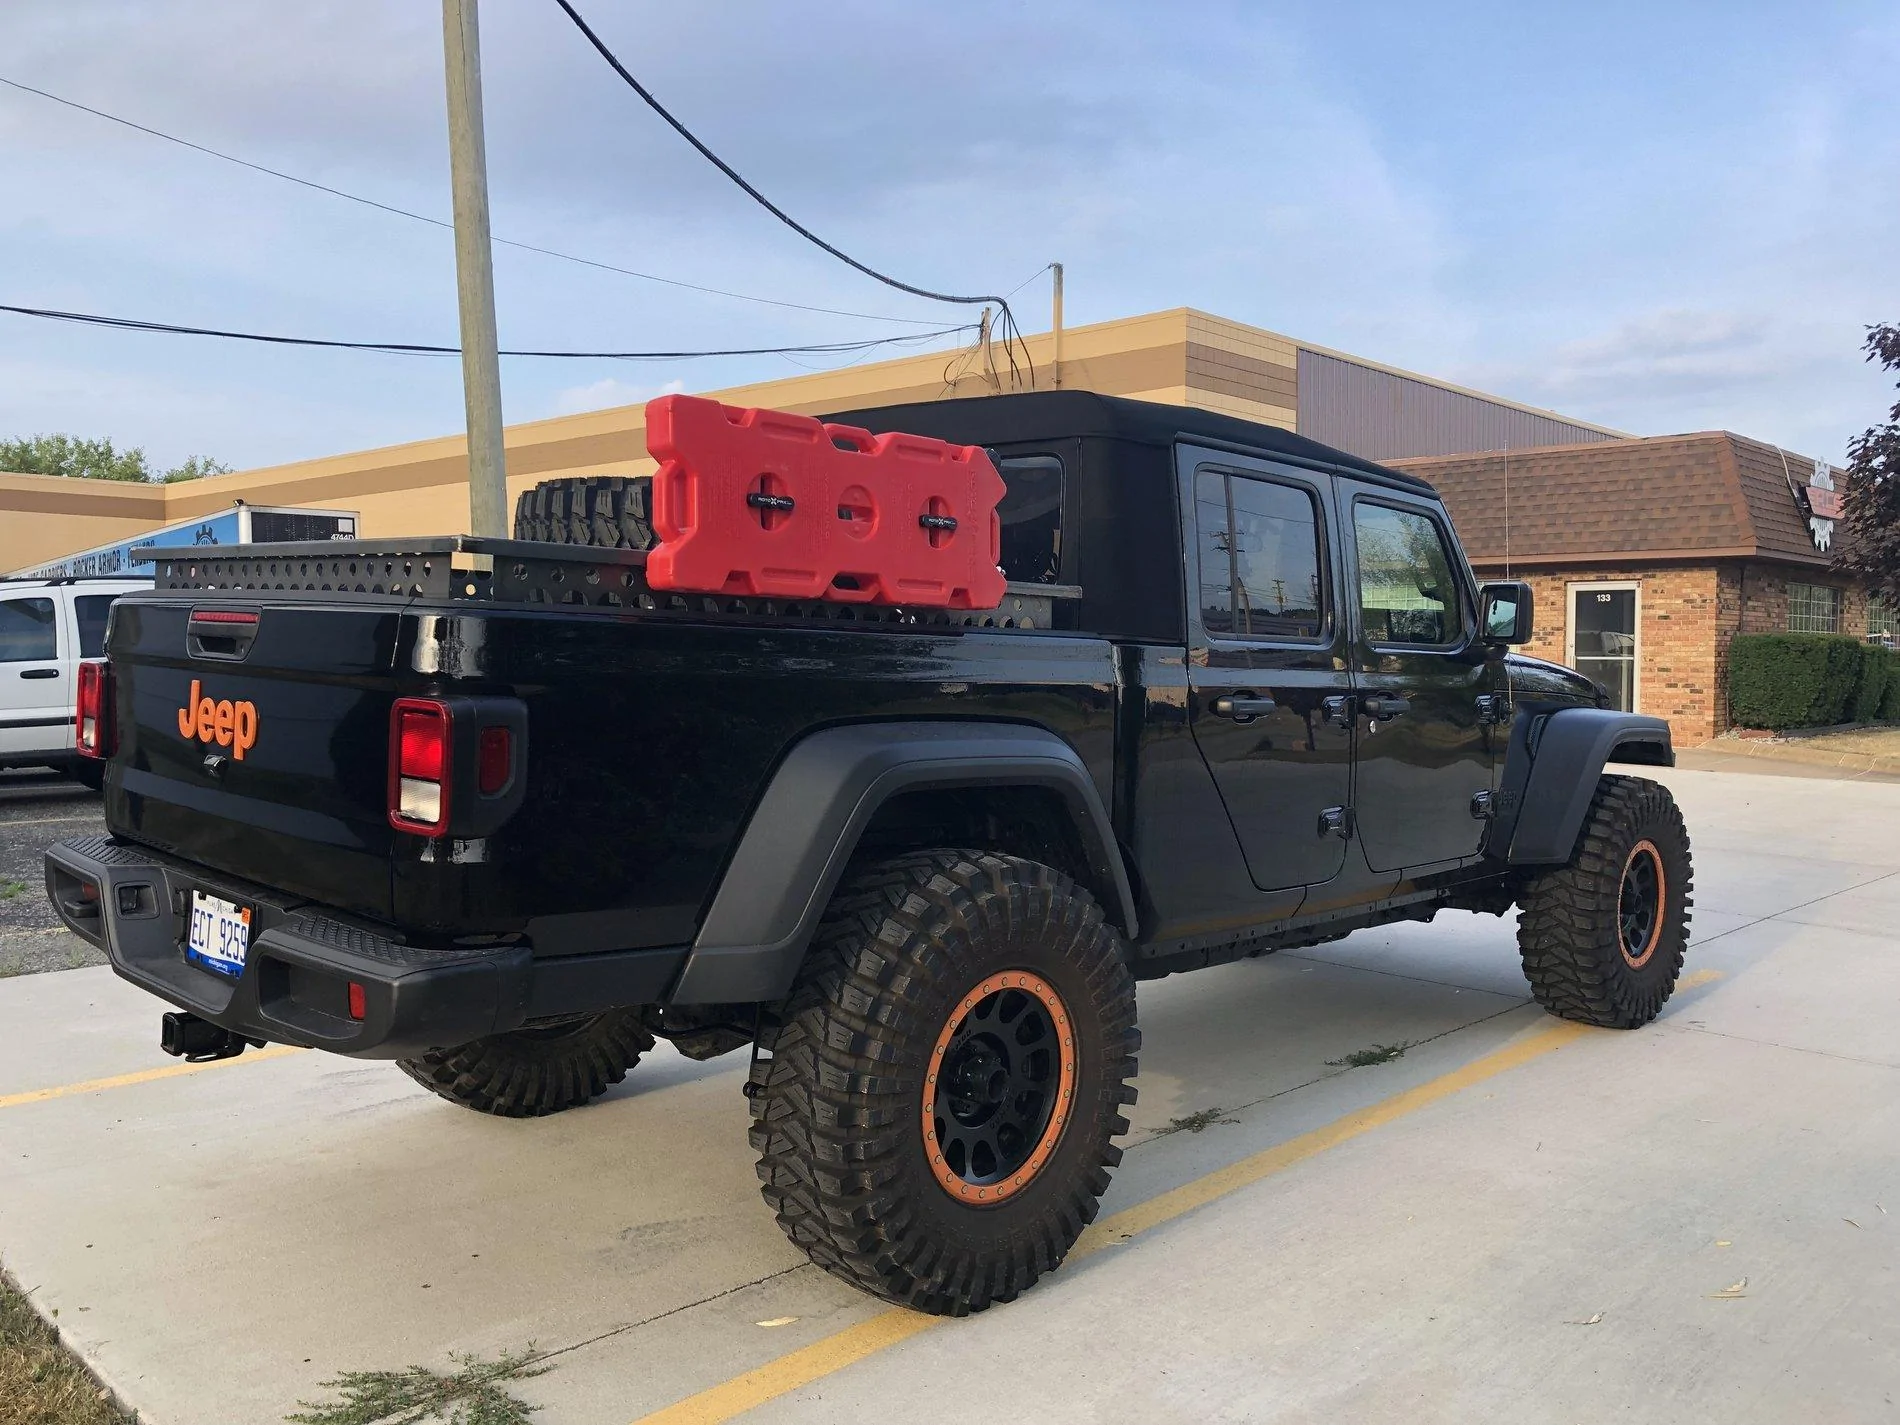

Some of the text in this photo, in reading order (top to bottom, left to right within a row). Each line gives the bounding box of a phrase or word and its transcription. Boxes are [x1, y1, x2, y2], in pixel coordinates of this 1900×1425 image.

[98, 548, 121, 575] ARMOR
[1596, 593, 1611, 602] 133
[178, 679, 258, 761] Jeep
[191, 907, 248, 962] ECT 9259
